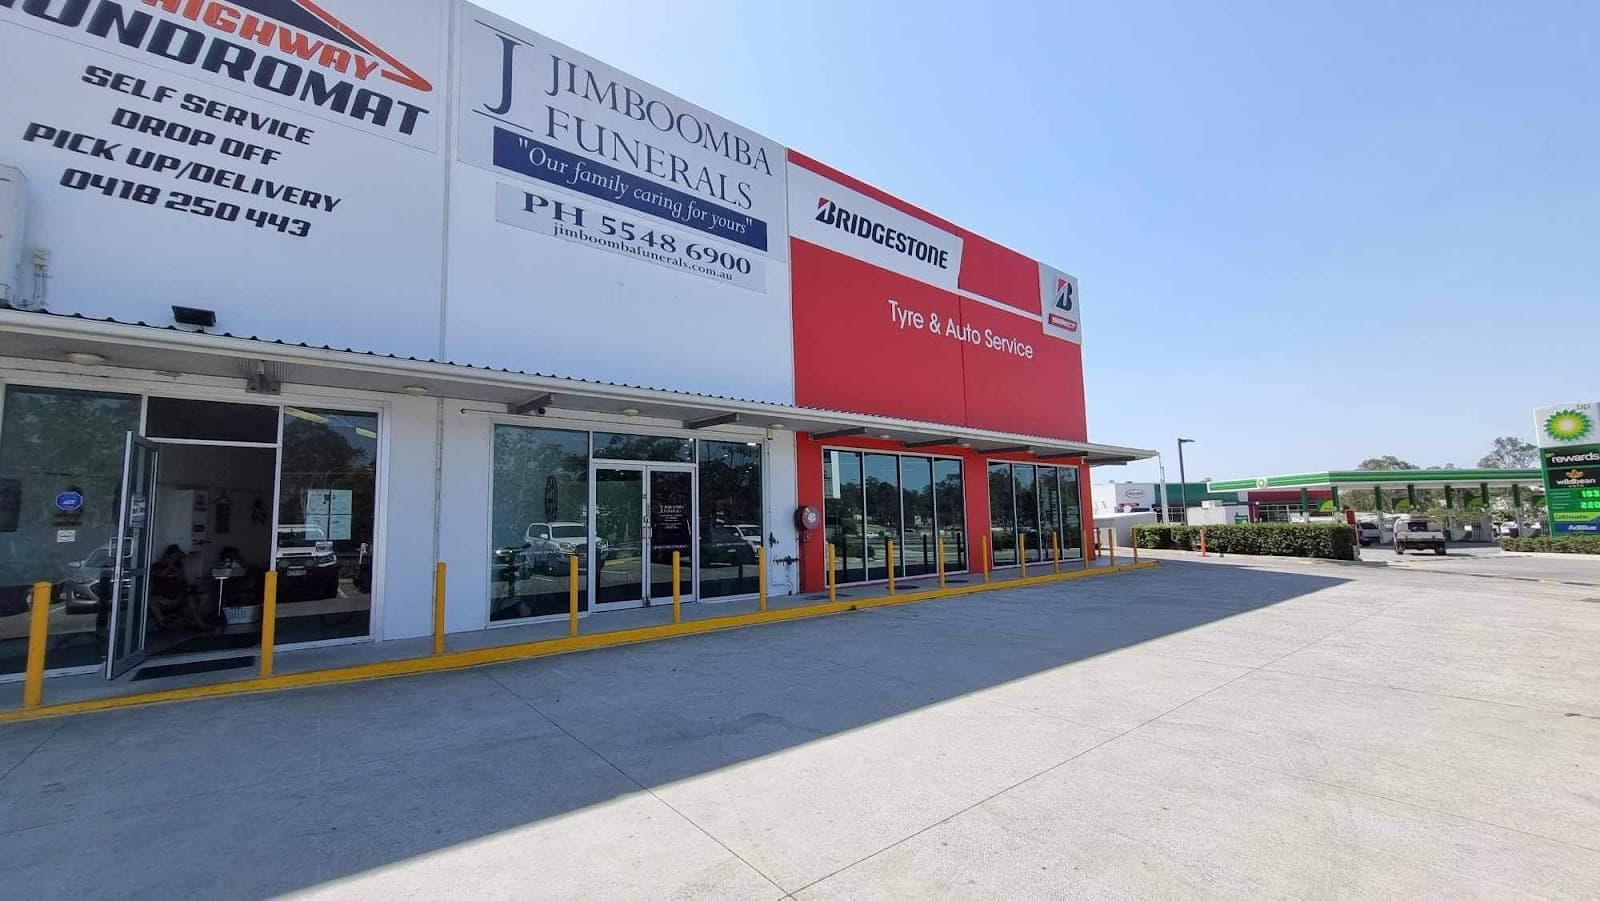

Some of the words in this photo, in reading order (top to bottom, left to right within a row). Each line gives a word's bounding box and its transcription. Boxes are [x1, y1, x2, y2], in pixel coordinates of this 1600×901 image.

[82, 65, 177, 103] SELF
[180, 93, 314, 145] SERVICE
[111, 107, 216, 146] DROP
[220, 137, 282, 165] OFF
[544, 54, 773, 176] JIMBOOMBA
[22, 122, 123, 161] PICK
[125, 147, 342, 213] UP/DELIVERY
[519, 137, 568, 173] "Our
[566, 161, 629, 199] family
[633, 188, 682, 219] caring
[682, 200, 707, 222] for
[708, 216, 752, 234] yours"
[545, 104, 752, 210] FUNERALS
[59, 168, 161, 205] 0418
[165, 191, 241, 222] 250
[245, 208, 312, 237] 443
[521, 191, 585, 228] PH
[601, 215, 676, 253] 5548
[686, 243, 751, 275] 6900
[815, 197, 948, 270] BRIDGESTONE
[553, 222, 733, 281] jimboombafunerals.com.au
[888, 299, 924, 329] Tyre
[929, 312, 941, 335] &
[945, 318, 981, 345] Auto
[984, 328, 1033, 359] Service
[1551, 452, 1600, 464] rewards
